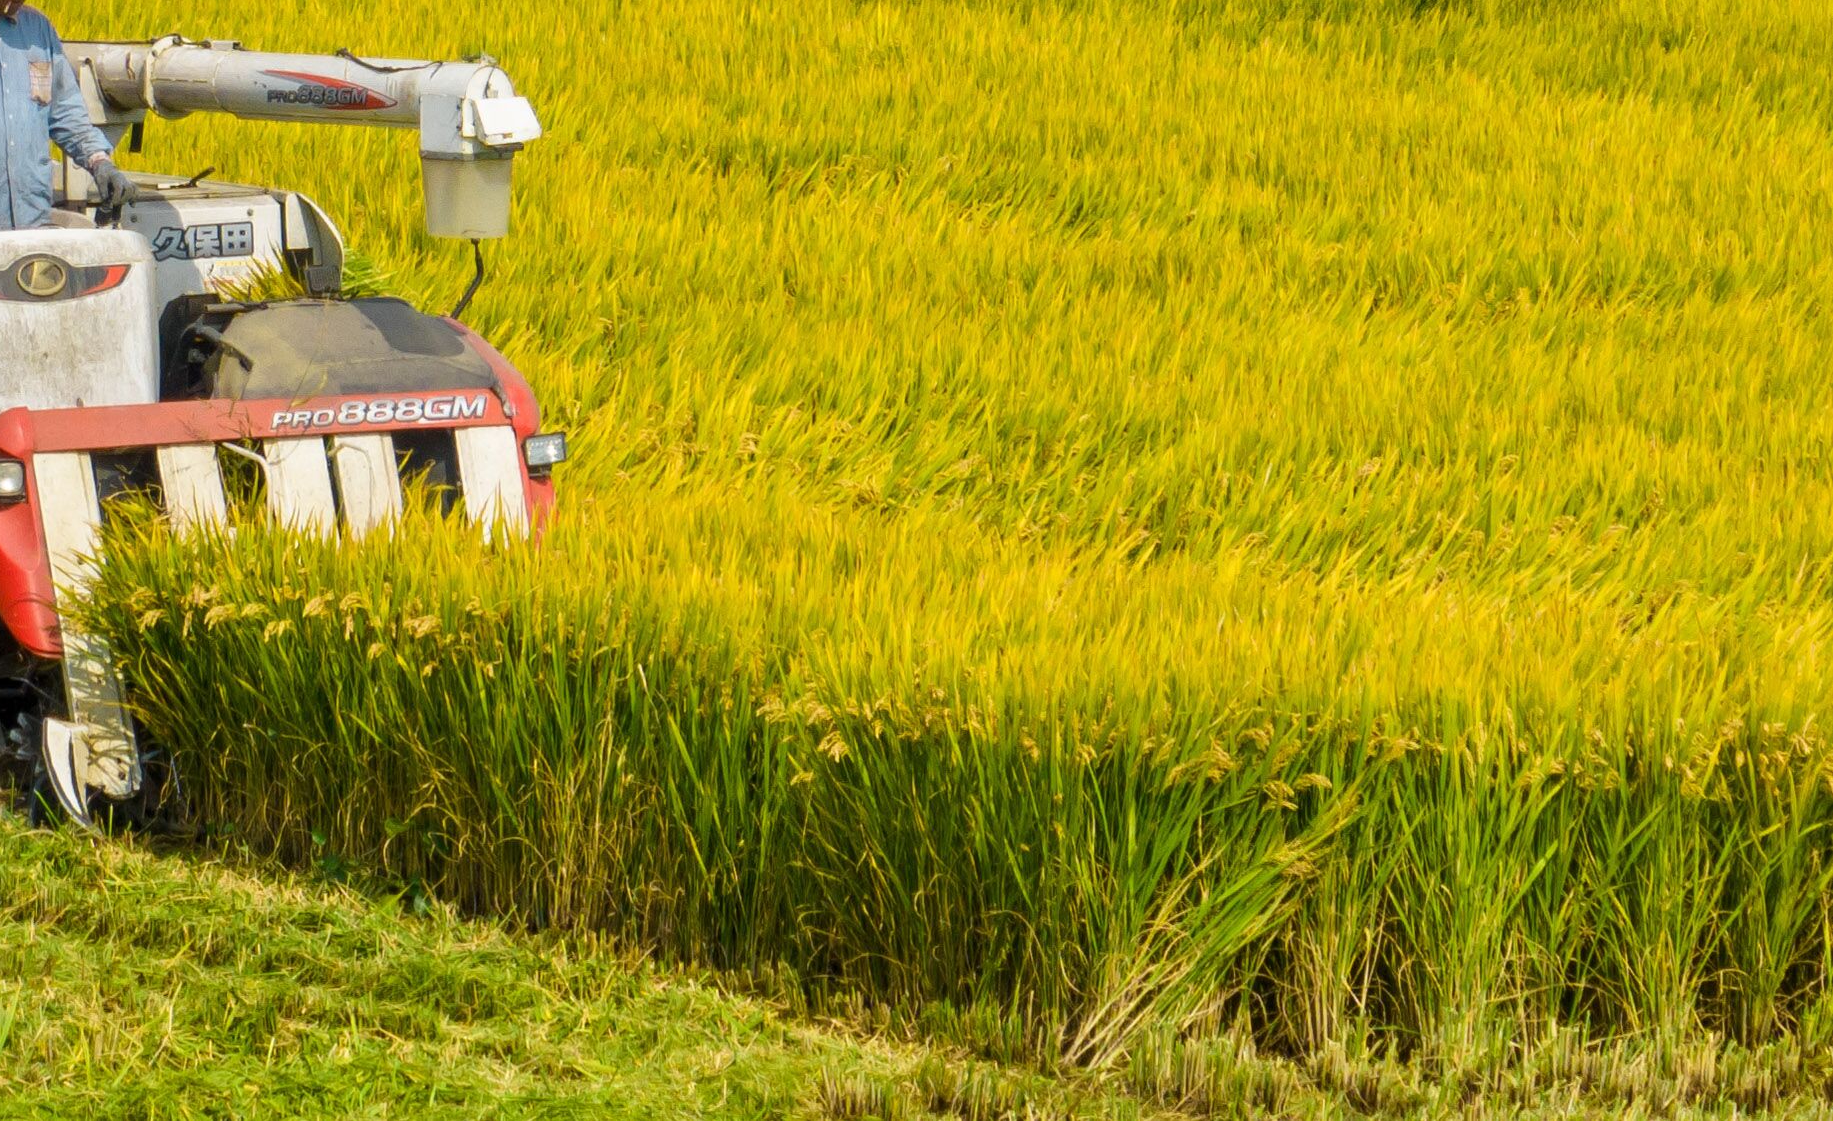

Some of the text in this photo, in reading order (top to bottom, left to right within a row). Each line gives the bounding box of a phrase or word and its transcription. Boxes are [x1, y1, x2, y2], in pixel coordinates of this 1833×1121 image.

[267, 84, 367, 105] PRO888GM
[152, 221, 254, 262] 久保田
[271, 394, 488, 430] PRO888GM
